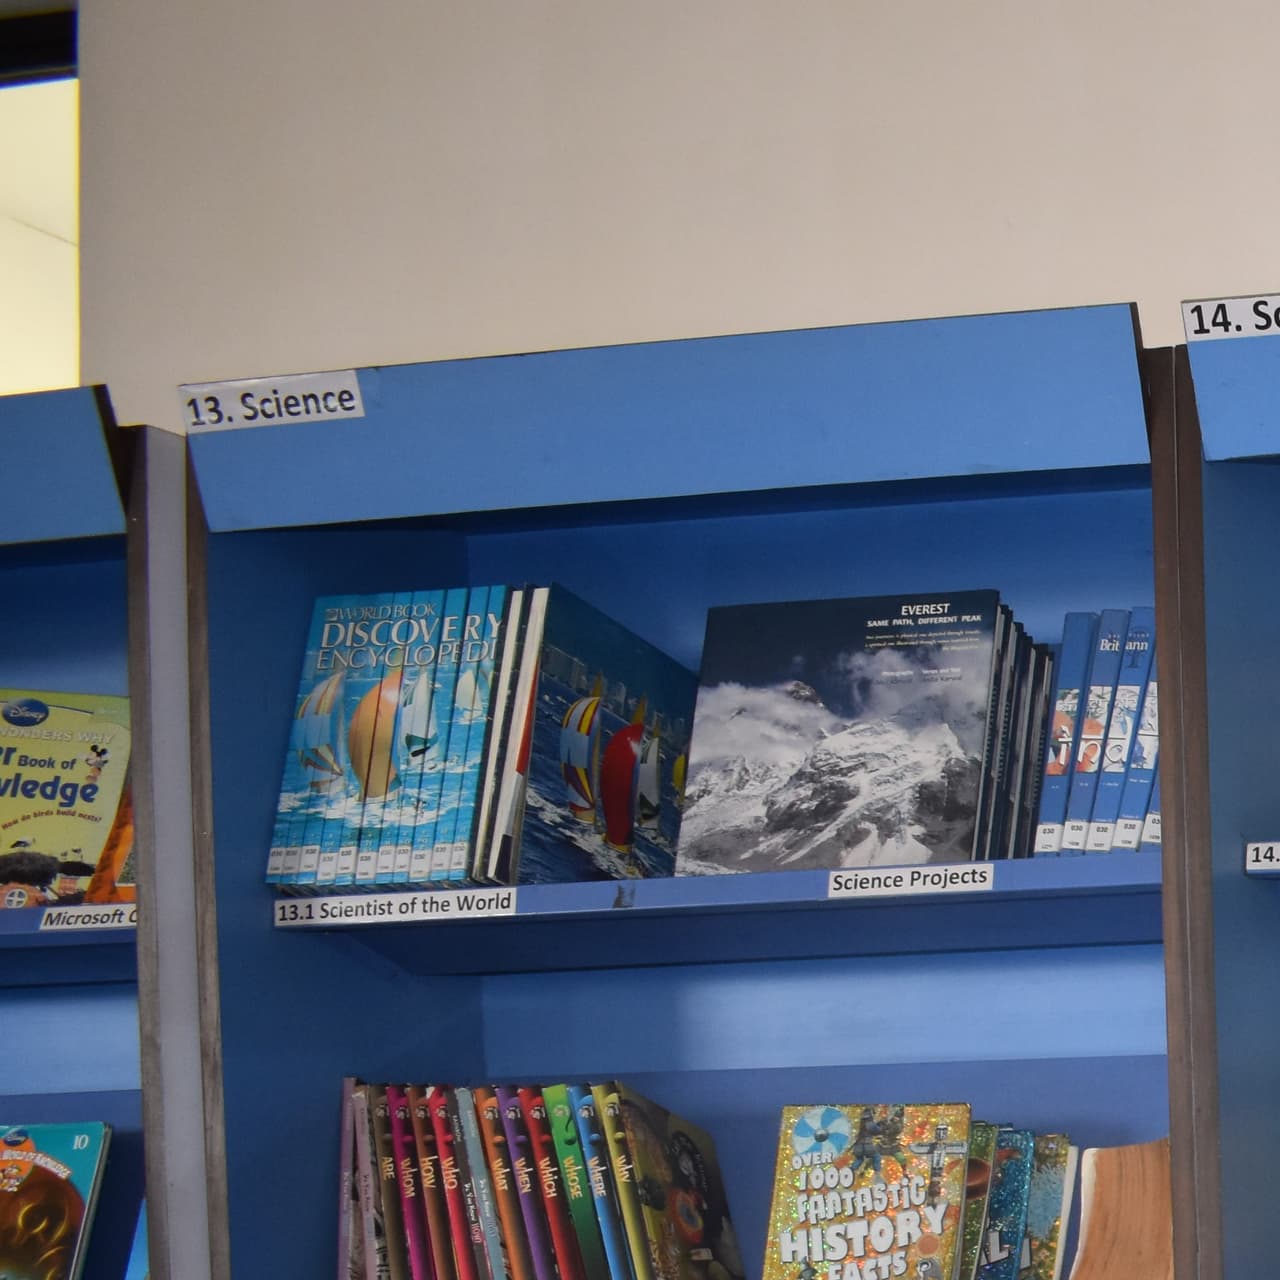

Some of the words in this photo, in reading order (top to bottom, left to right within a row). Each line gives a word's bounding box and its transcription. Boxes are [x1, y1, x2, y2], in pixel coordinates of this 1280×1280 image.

[1190, 303, 1243, 335] 14.
[187, 396, 234, 427] 13.
[241, 384, 356, 421] Science
[866, 620, 889, 628] SAME
[918, 616, 958, 625] DIFFERENT
[901, 603, 951, 615] EVEREST
[321, 613, 504, 648] DISCOVERY
[833, 872, 904, 891] Science
[909, 868, 988, 891] Projects
[44, 909, 124, 927] Microsoft
[278, 904, 315, 921] 13.1
[320, 900, 393, 919] Scientist
[399, 896, 417, 914] of
[422, 896, 450, 913] the
[456, 892, 512, 911] World
[72, 1134, 89, 1151] 10
[441, 1156, 461, 1189] WHO
[792, 1152, 834, 1170] OVER
[588, 1155, 609, 1199] WHERE
[799, 1166, 854, 1191] 1000
[797, 1175, 927, 1225] FANTASTIC
[780, 1201, 949, 1263] HISTORY
